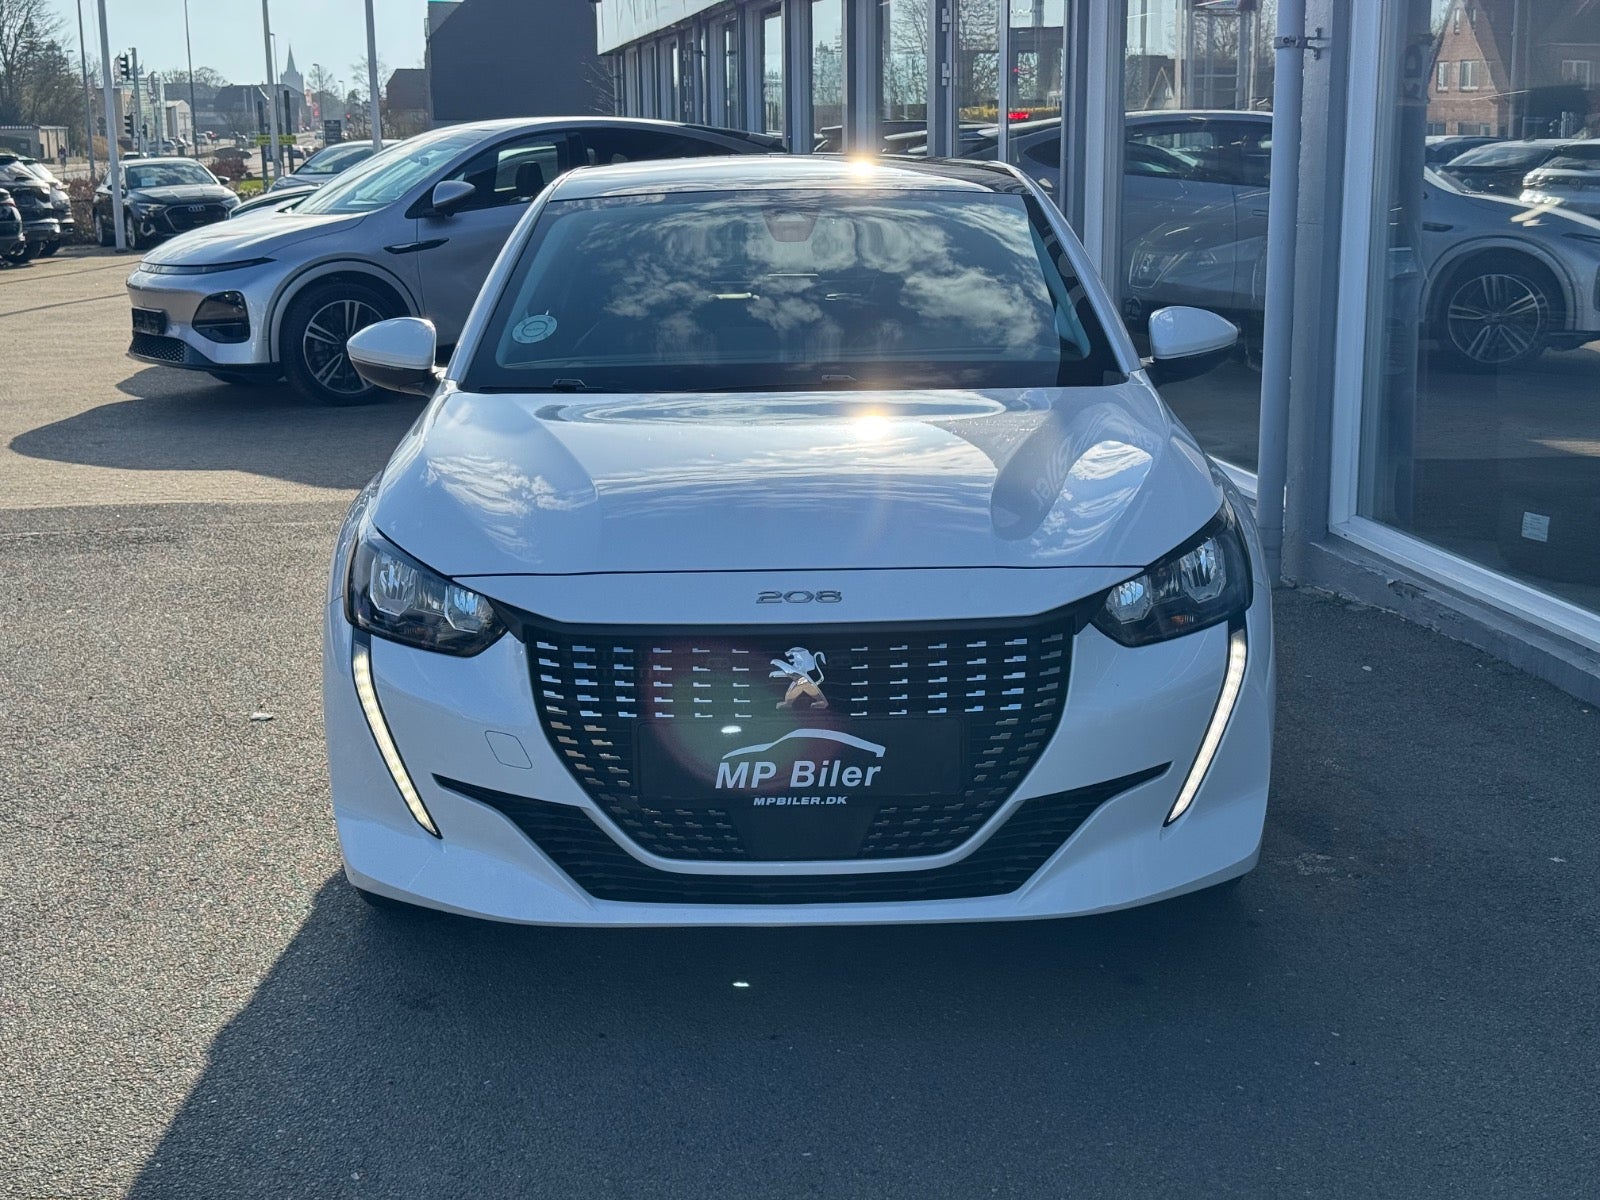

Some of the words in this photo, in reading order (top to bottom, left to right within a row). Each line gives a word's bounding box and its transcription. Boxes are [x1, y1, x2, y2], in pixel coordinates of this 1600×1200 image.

[756, 590, 842, 604] 208
[715, 761, 777, 789] MP
[790, 760, 881, 788] Biler
[753, 796, 848, 806] MPBILER.DK
